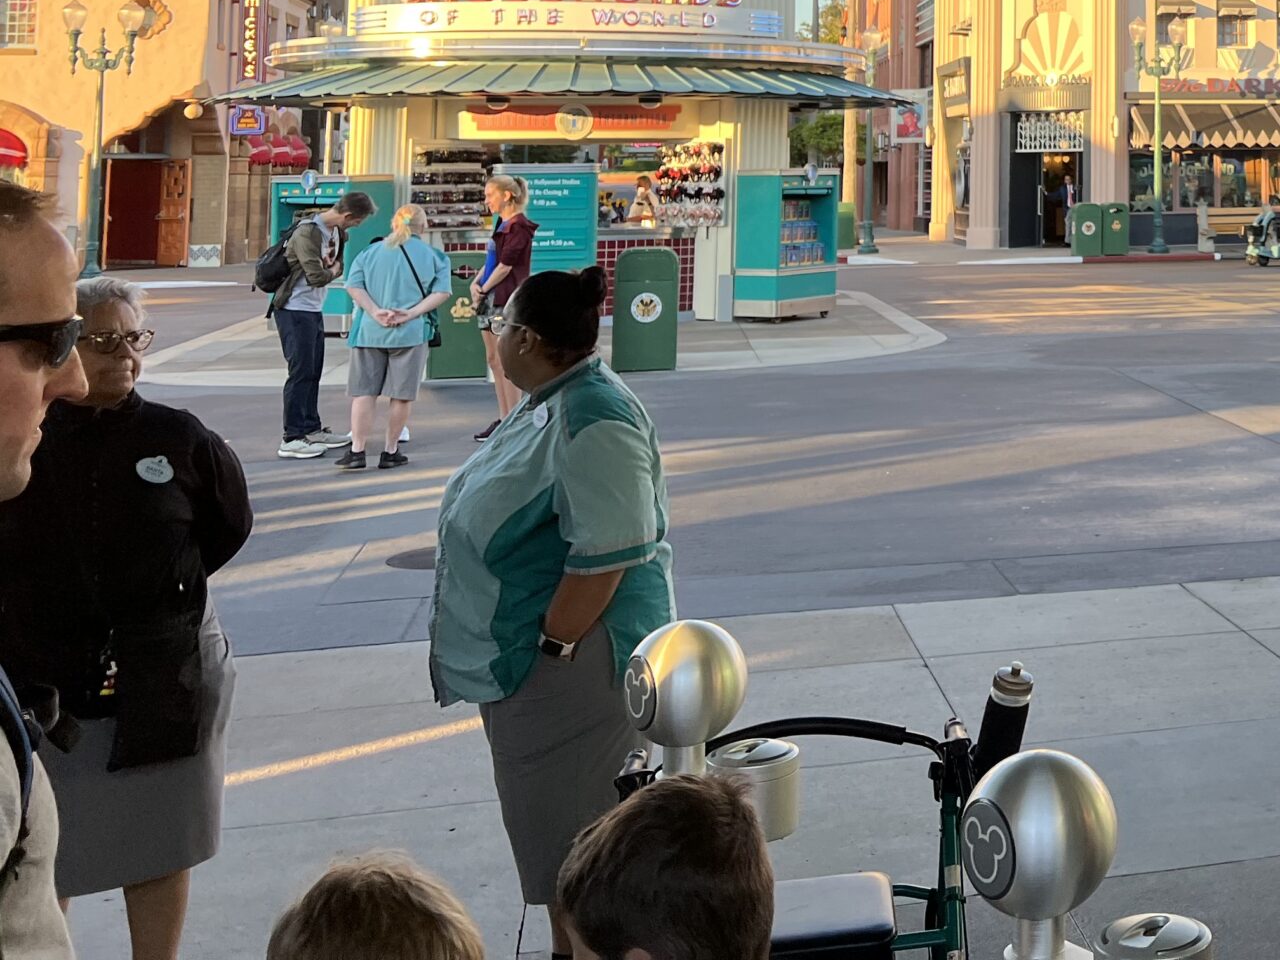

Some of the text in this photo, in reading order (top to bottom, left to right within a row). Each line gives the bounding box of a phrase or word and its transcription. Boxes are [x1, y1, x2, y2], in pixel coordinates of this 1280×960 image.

[419, 7, 718, 29] OF THE WORLD
